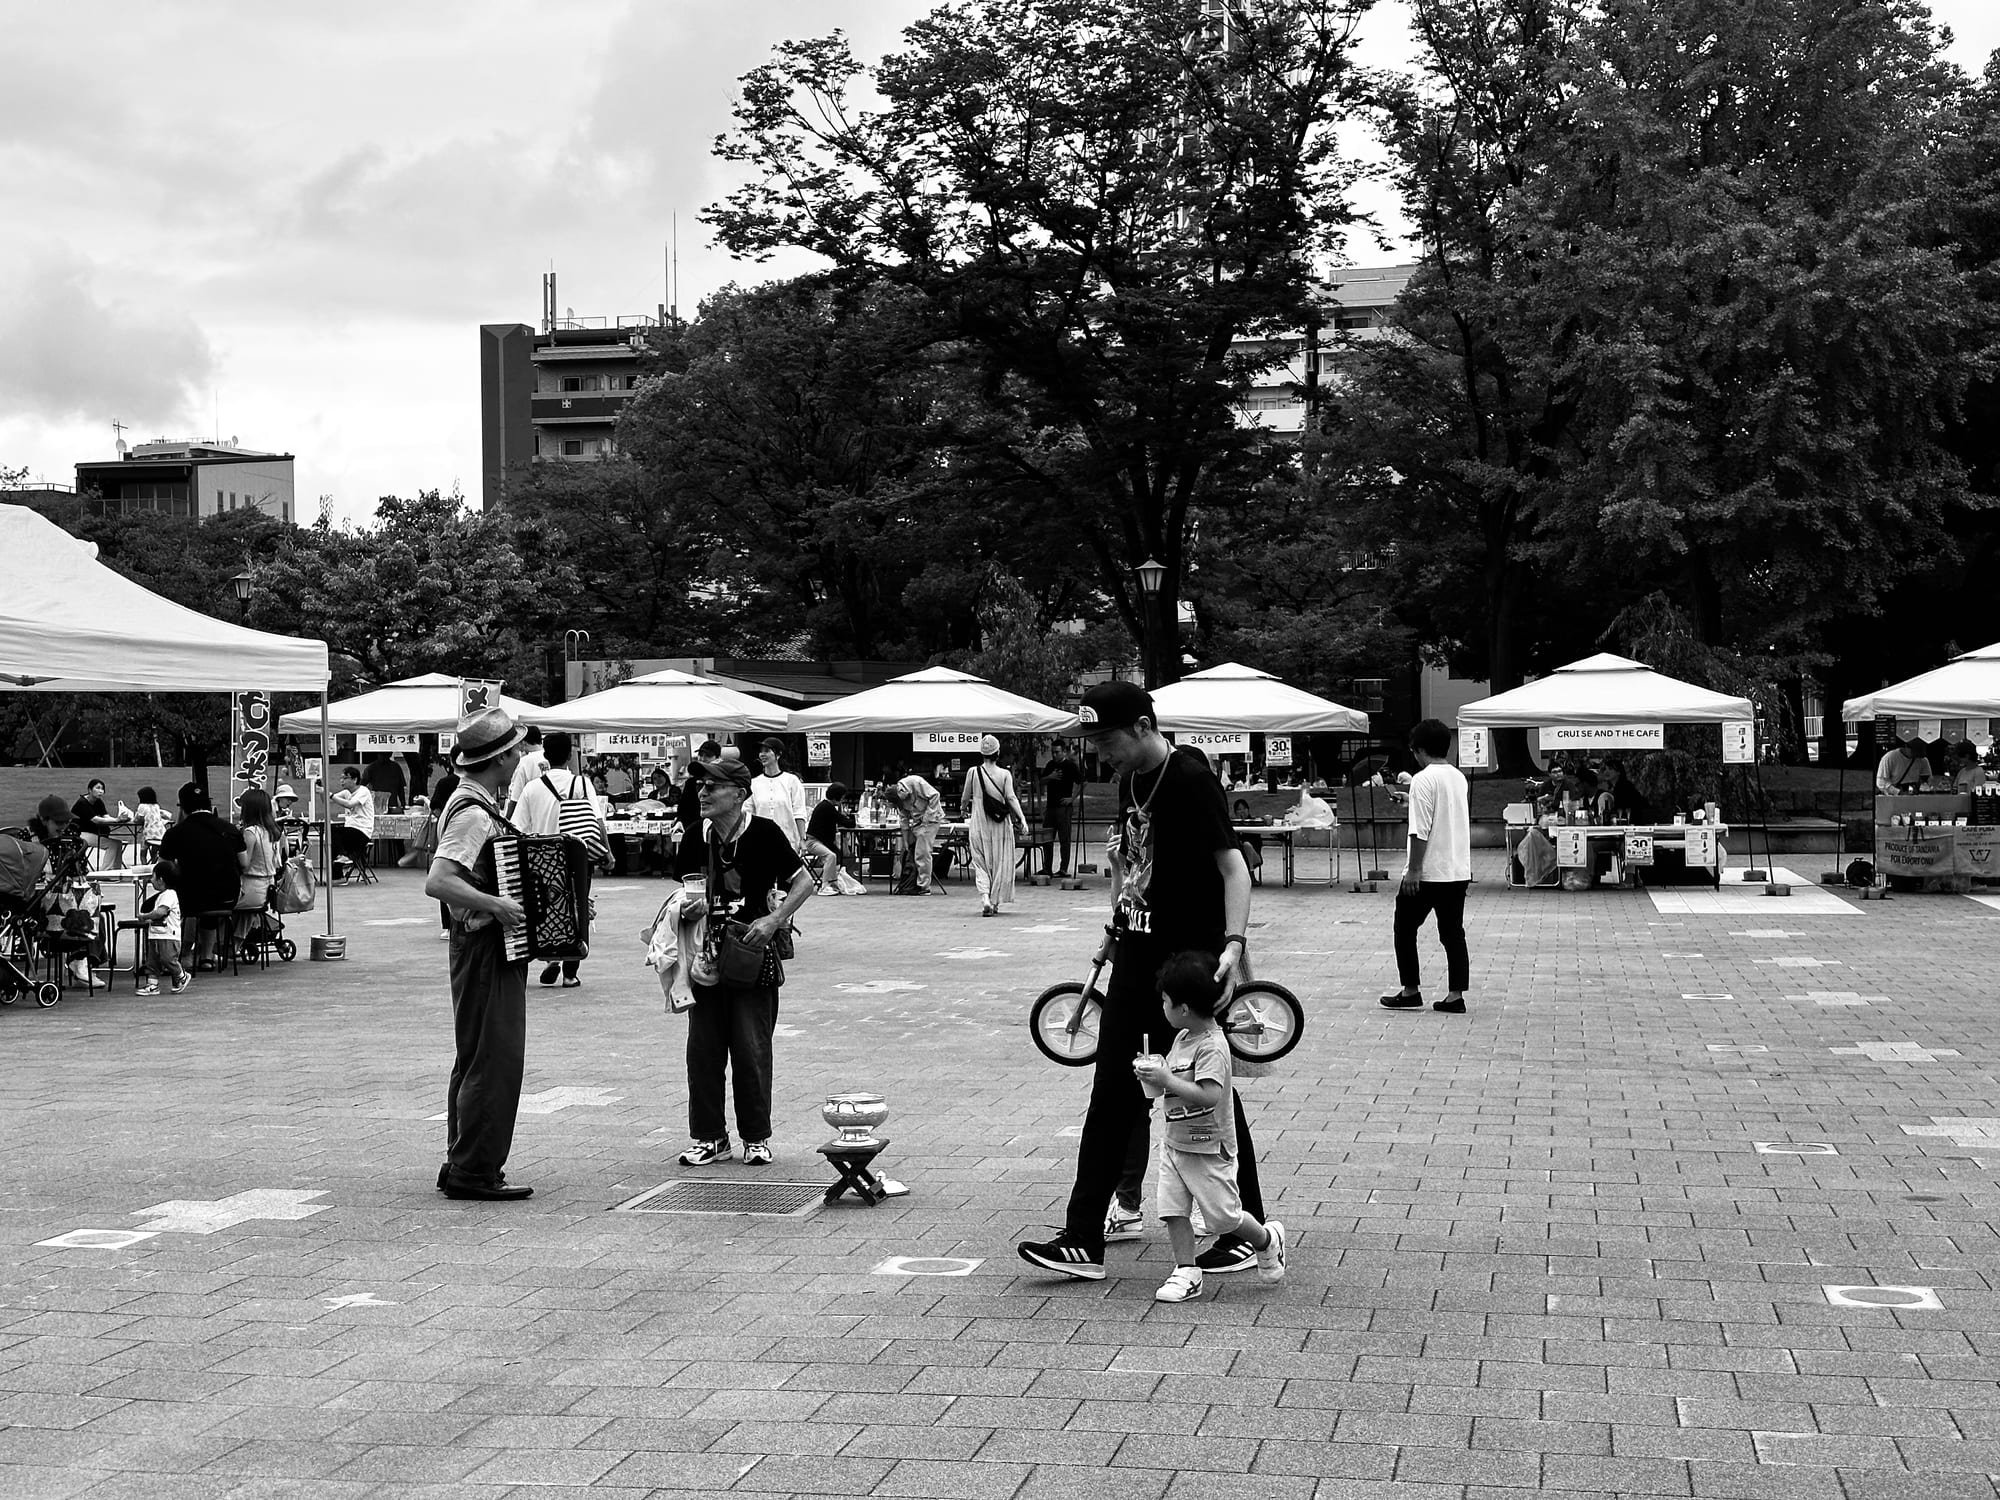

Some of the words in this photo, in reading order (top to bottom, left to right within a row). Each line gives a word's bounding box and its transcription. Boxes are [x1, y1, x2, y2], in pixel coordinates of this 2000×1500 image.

[929, 733, 955, 743] Blue
[958, 733, 980, 743] Bee
[1190, 735, 1212, 744] 36's
[1214, 734, 1242, 744] CAFE
[1557, 730, 1593, 739] CRUISE
[1594, 730, 1614, 738] AND
[1615, 730, 1635, 738] THE
[1636, 729, 1660, 737] CAFE
[368, 734, 416, 745] 両国もつ煮
[1271, 740, 1287, 752] 30
